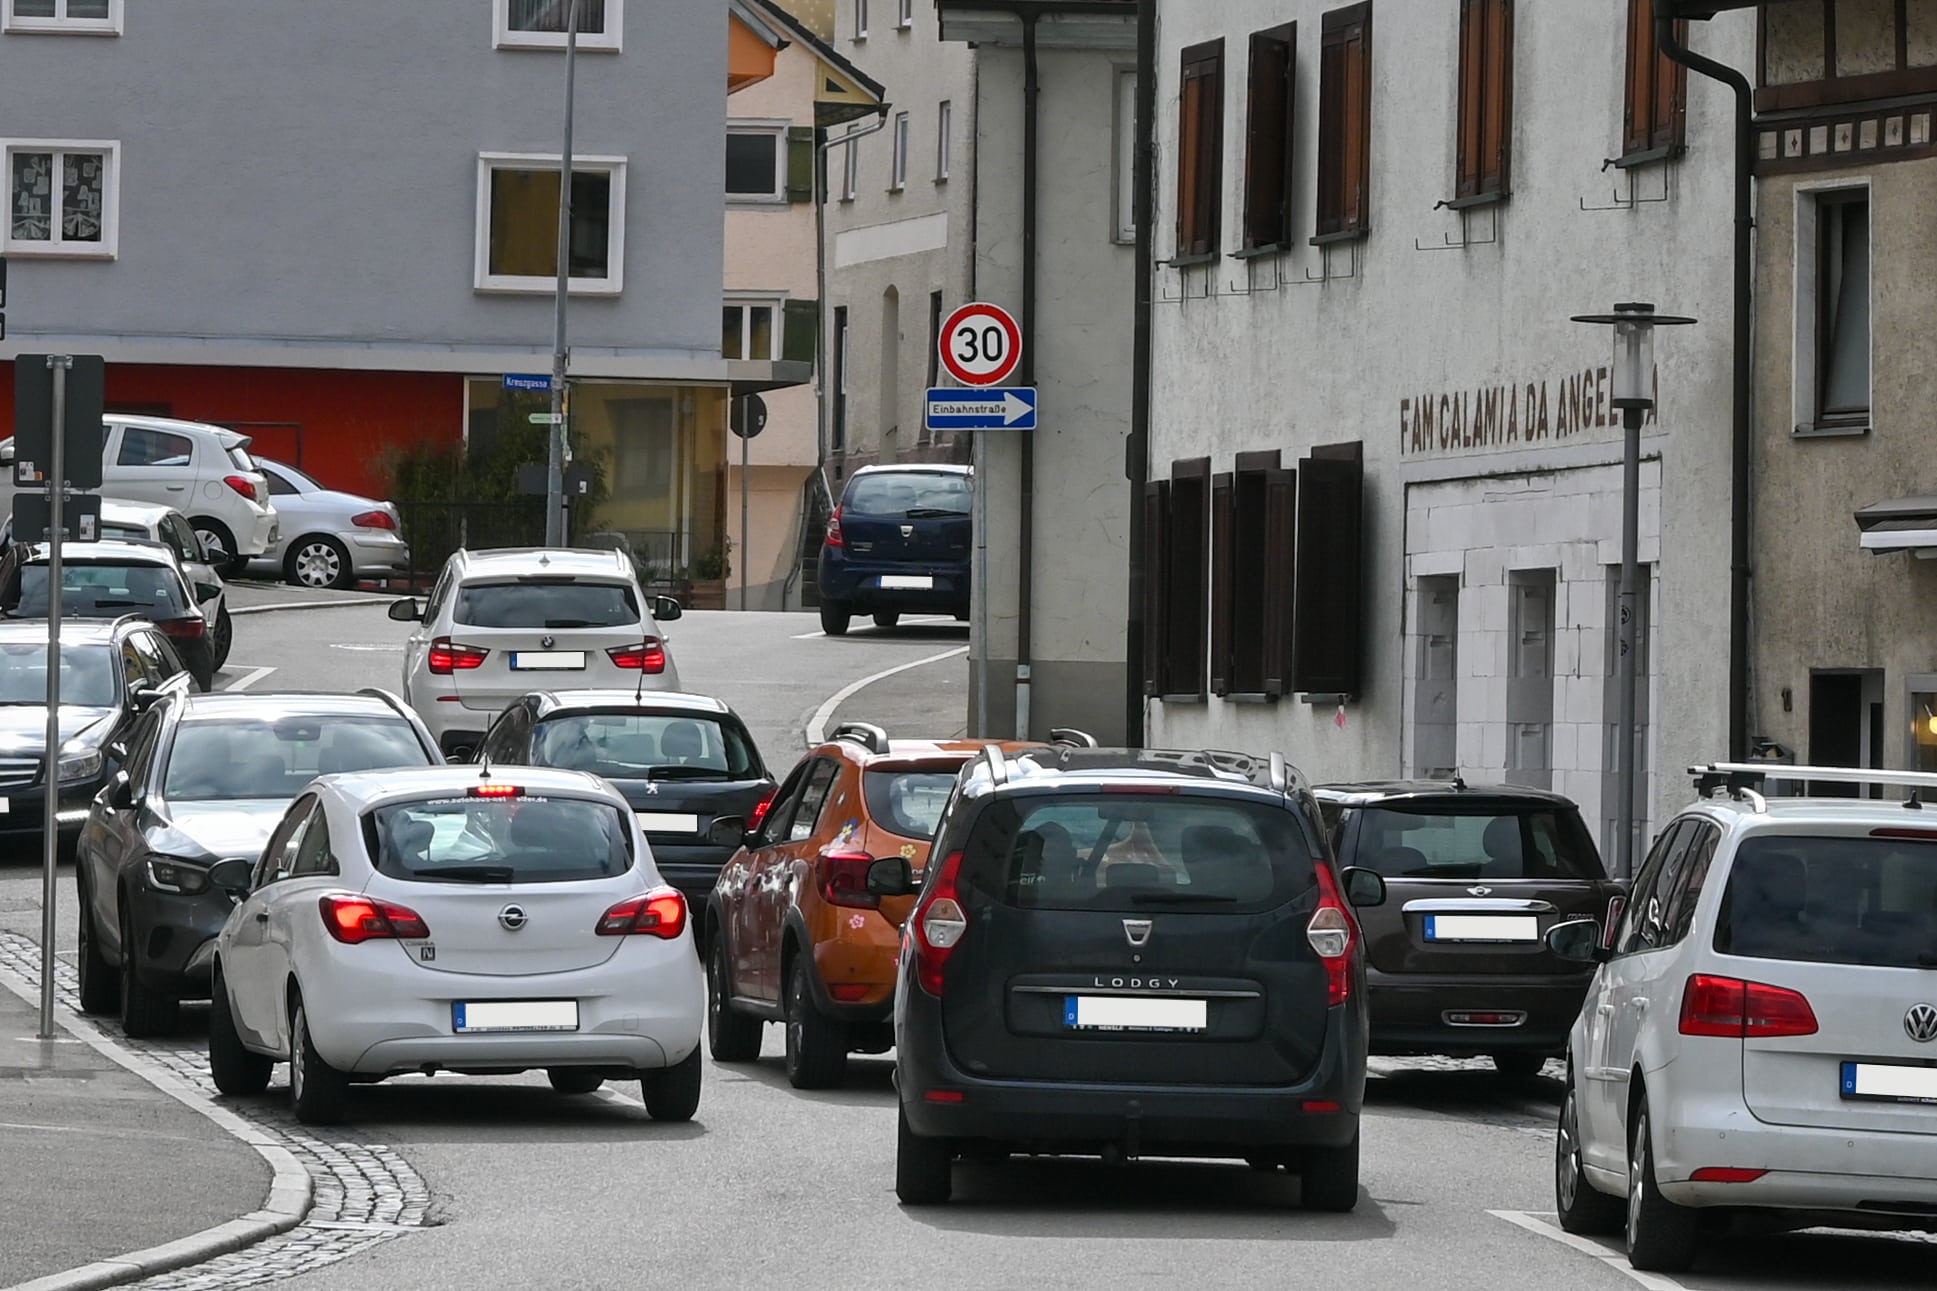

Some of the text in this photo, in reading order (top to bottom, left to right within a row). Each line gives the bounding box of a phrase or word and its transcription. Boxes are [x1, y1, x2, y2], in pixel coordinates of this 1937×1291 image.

[957, 325, 1003, 363] 30
[932, 404, 1007, 414] Einbahnstraße
[1400, 393, 1434, 456] FAM
[1440, 382, 1518, 450] CALAMIA
[1525, 380, 1549, 442] DA
[1094, 976, 1179, 989] LODGY
[1068, 1012, 1075, 1020] D
[1846, 1081, 1853, 1089] D
